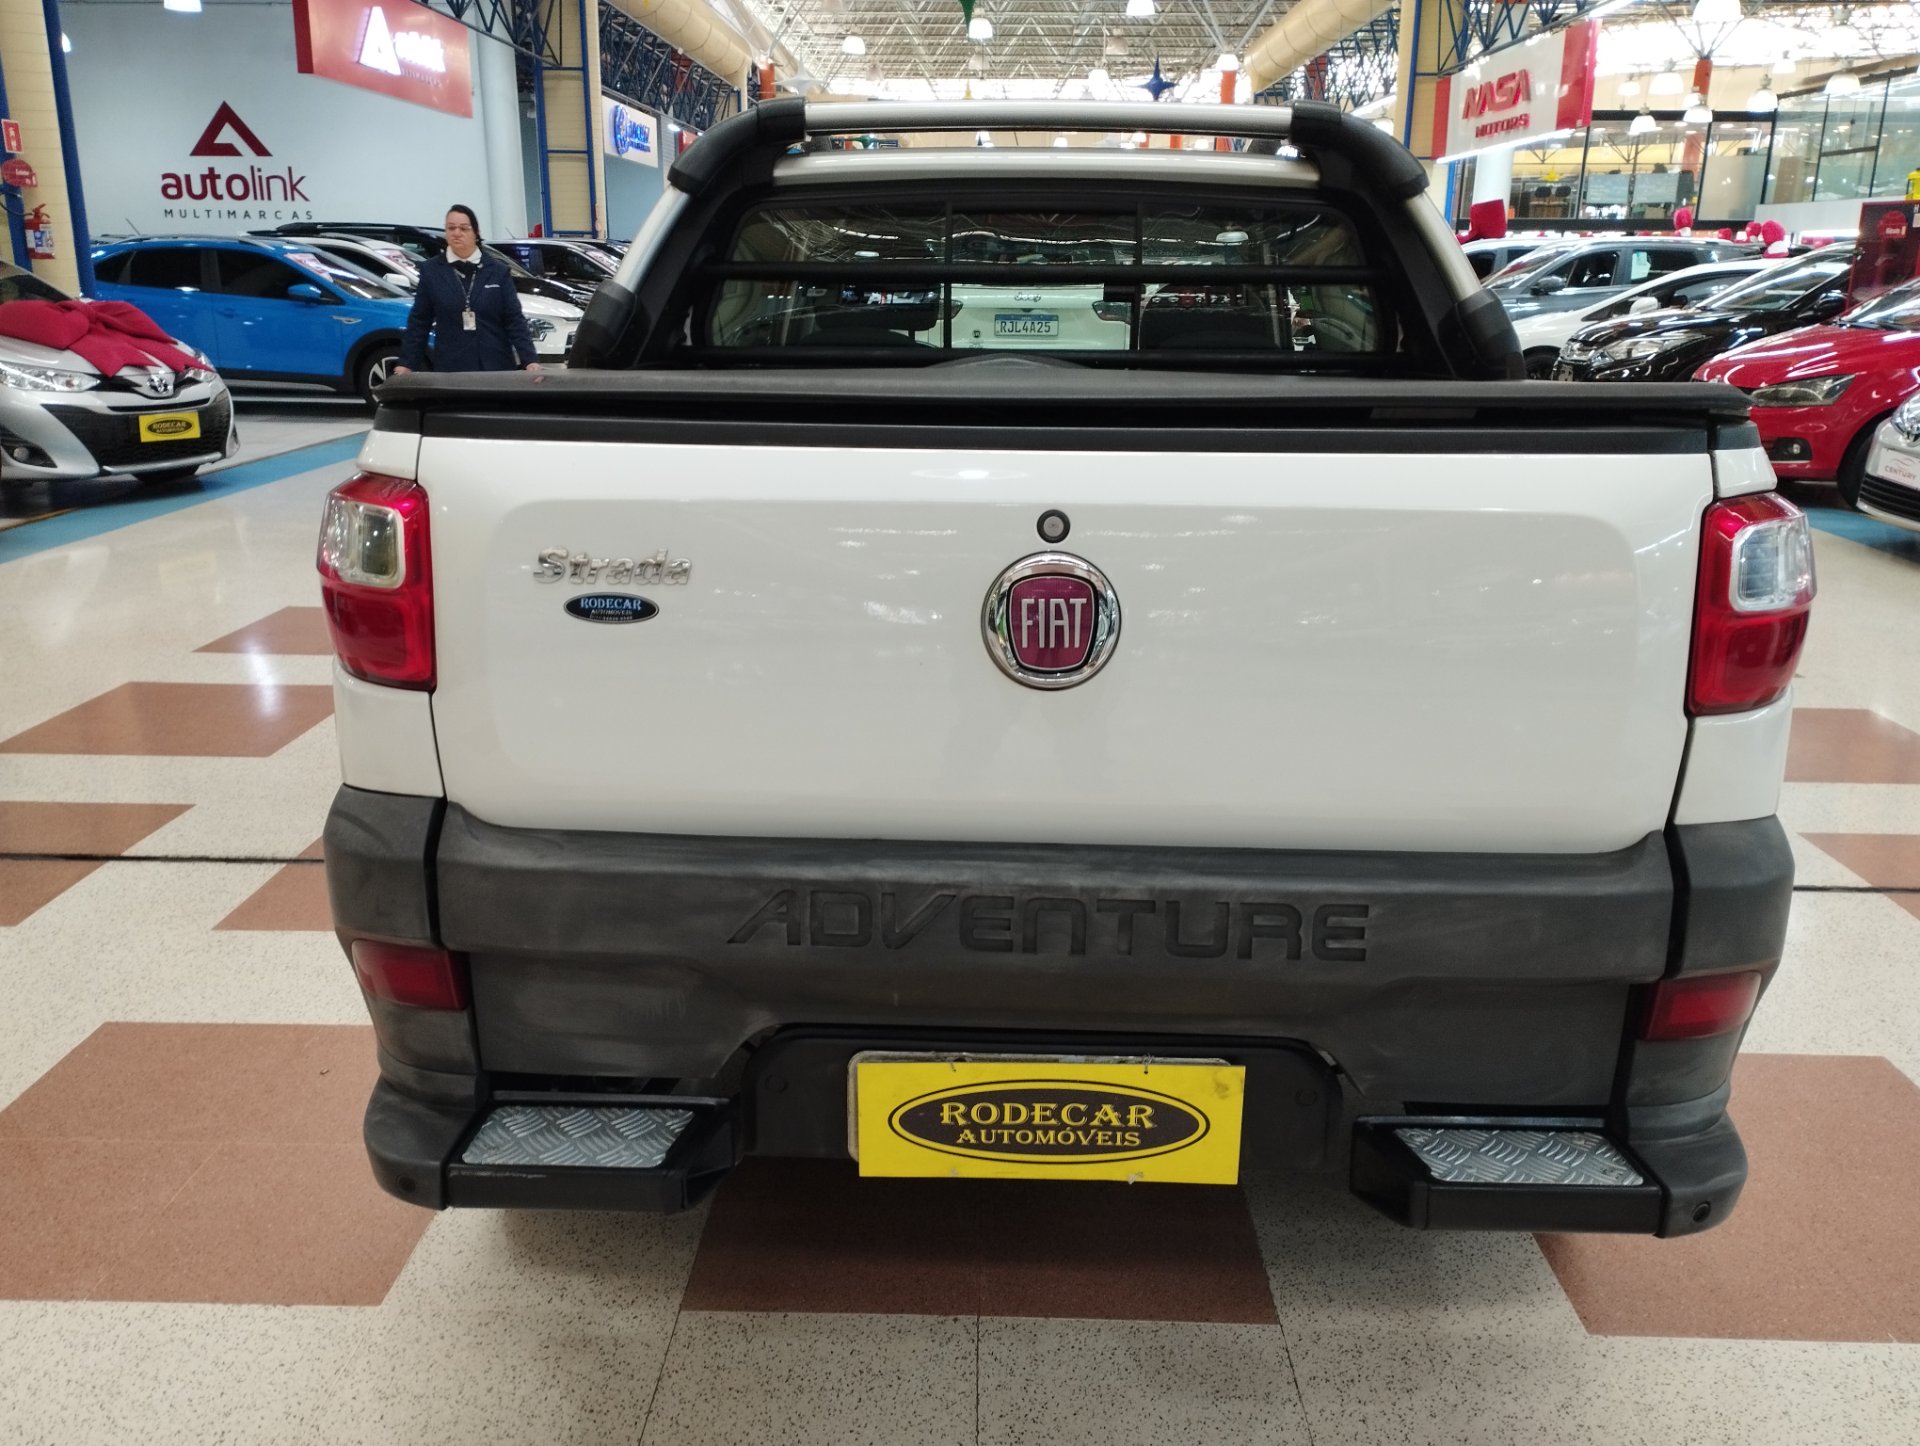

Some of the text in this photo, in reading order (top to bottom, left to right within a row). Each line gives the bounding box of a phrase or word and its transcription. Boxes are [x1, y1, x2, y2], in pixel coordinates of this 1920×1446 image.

[1462, 68, 1531, 120] NASA
[1475, 113, 1529, 138] MOTORS
[161, 165, 310, 202] autolink
[164, 208, 313, 220] MULTIMARCAS
[1000, 321, 1051, 333] RJL4A25
[533, 546, 693, 586] Strada
[580, 597, 642, 610] RODECAR
[1021, 598, 1087, 649] FIAT
[726, 888, 1370, 962] ADVENTURE
[940, 1102, 1157, 1129] RODECAR
[956, 1127, 1141, 1147] AUTOMÓVEIS
